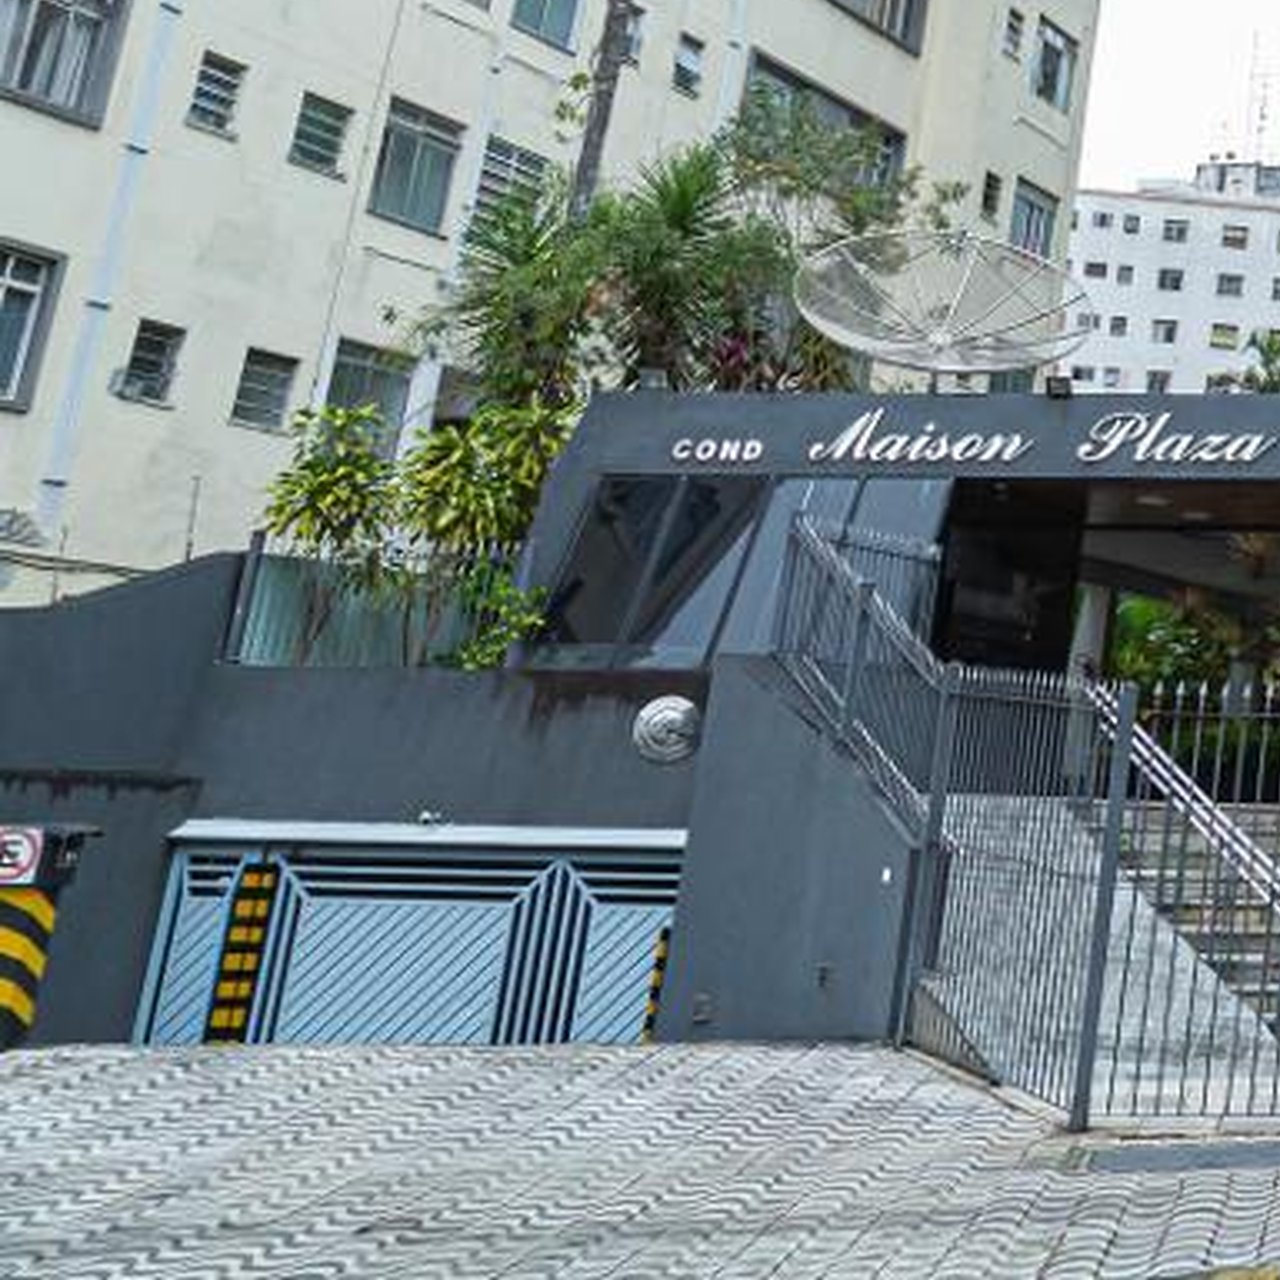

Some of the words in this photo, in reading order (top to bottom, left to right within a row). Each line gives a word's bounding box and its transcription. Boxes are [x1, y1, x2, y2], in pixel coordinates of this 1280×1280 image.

[671, 437, 765, 461] COND
[807, 407, 1035, 462] Maison
[1075, 411, 1279, 463] Plaza
